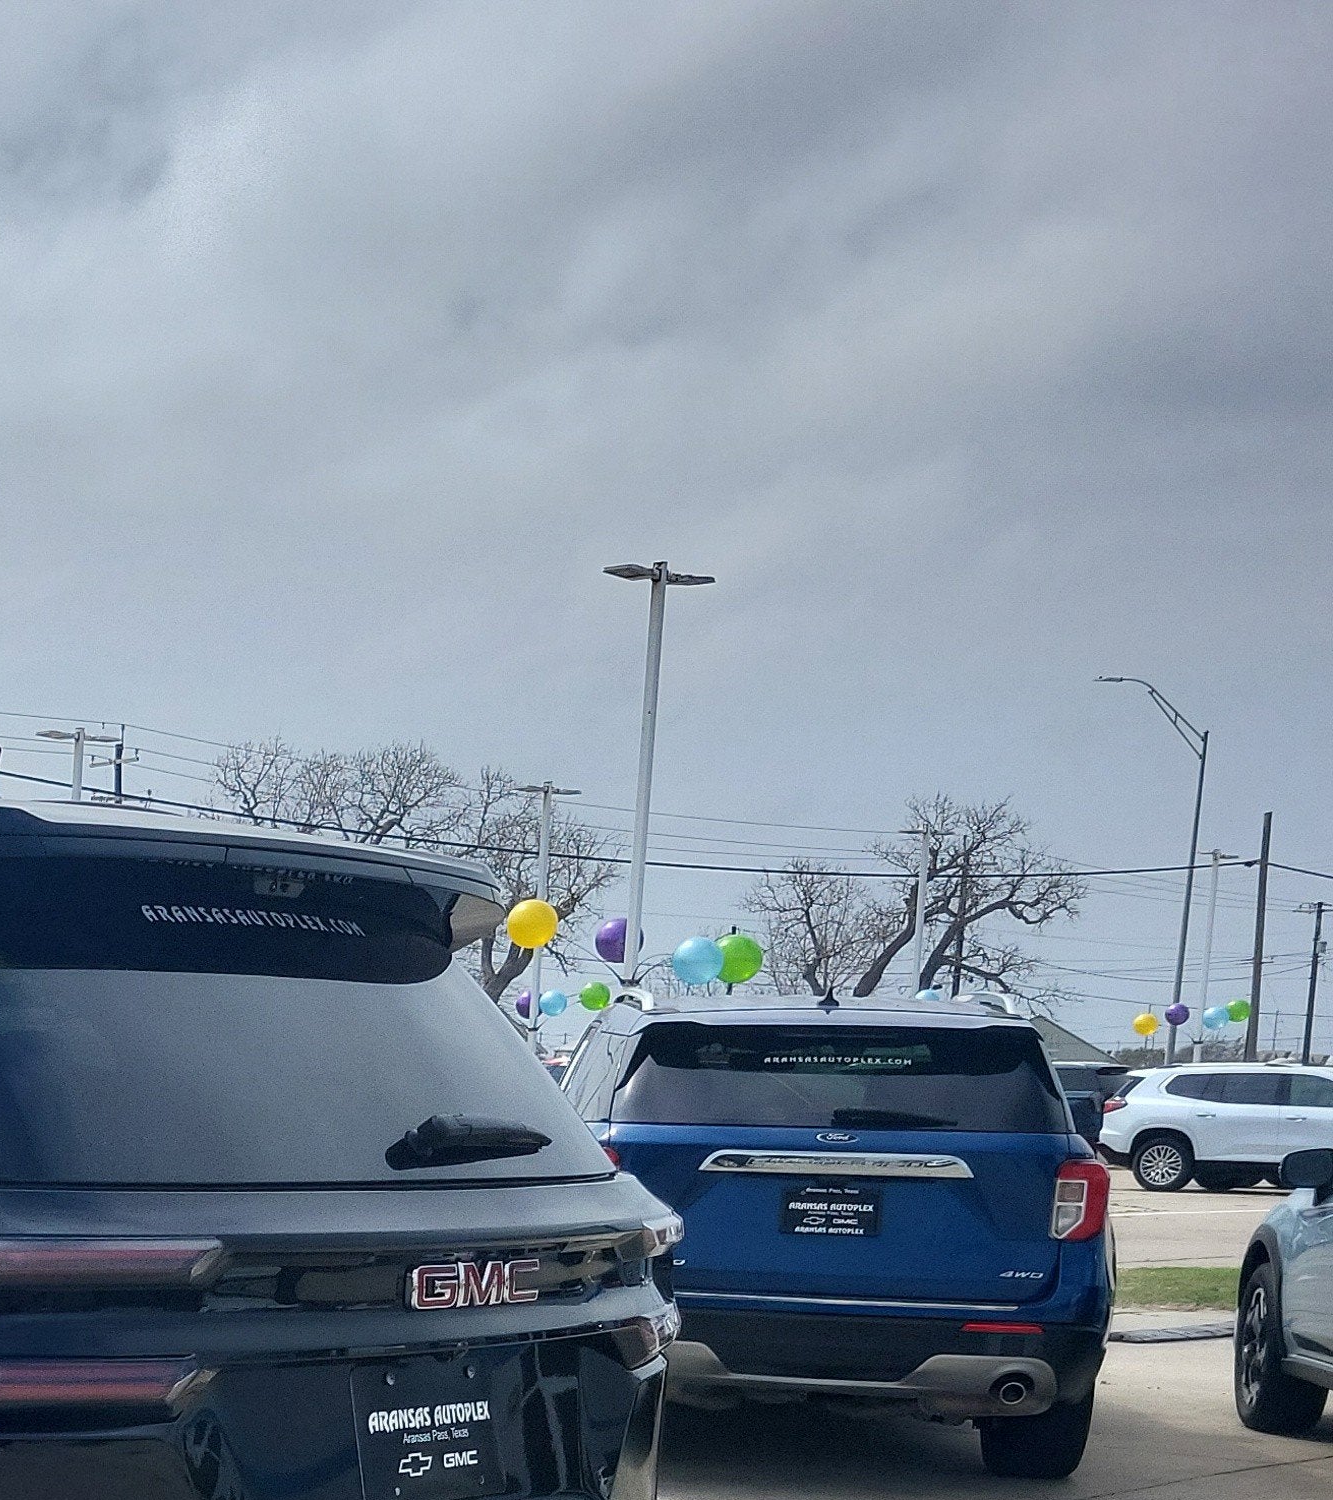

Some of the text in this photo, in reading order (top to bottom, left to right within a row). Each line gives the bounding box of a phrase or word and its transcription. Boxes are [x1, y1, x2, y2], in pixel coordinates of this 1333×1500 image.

[141, 904, 366, 937] ARANSASAUTOPLEX.COM
[763, 1056, 913, 1067] ARANSASAUTOPLEX.COM
[788, 1202, 874, 1212] ARANSAS AUTOPLEX
[828, 1227, 865, 1235] AUTOPLEX
[998, 1270, 1044, 1279] 4WD
[410, 1258, 540, 1310] GMC
[368, 1400, 491, 1434] ARANSAS AUTOPLEX
[403, 1427, 469, 1444] Aransas Pass, Texas
[443, 1450, 478, 1468] GMC
